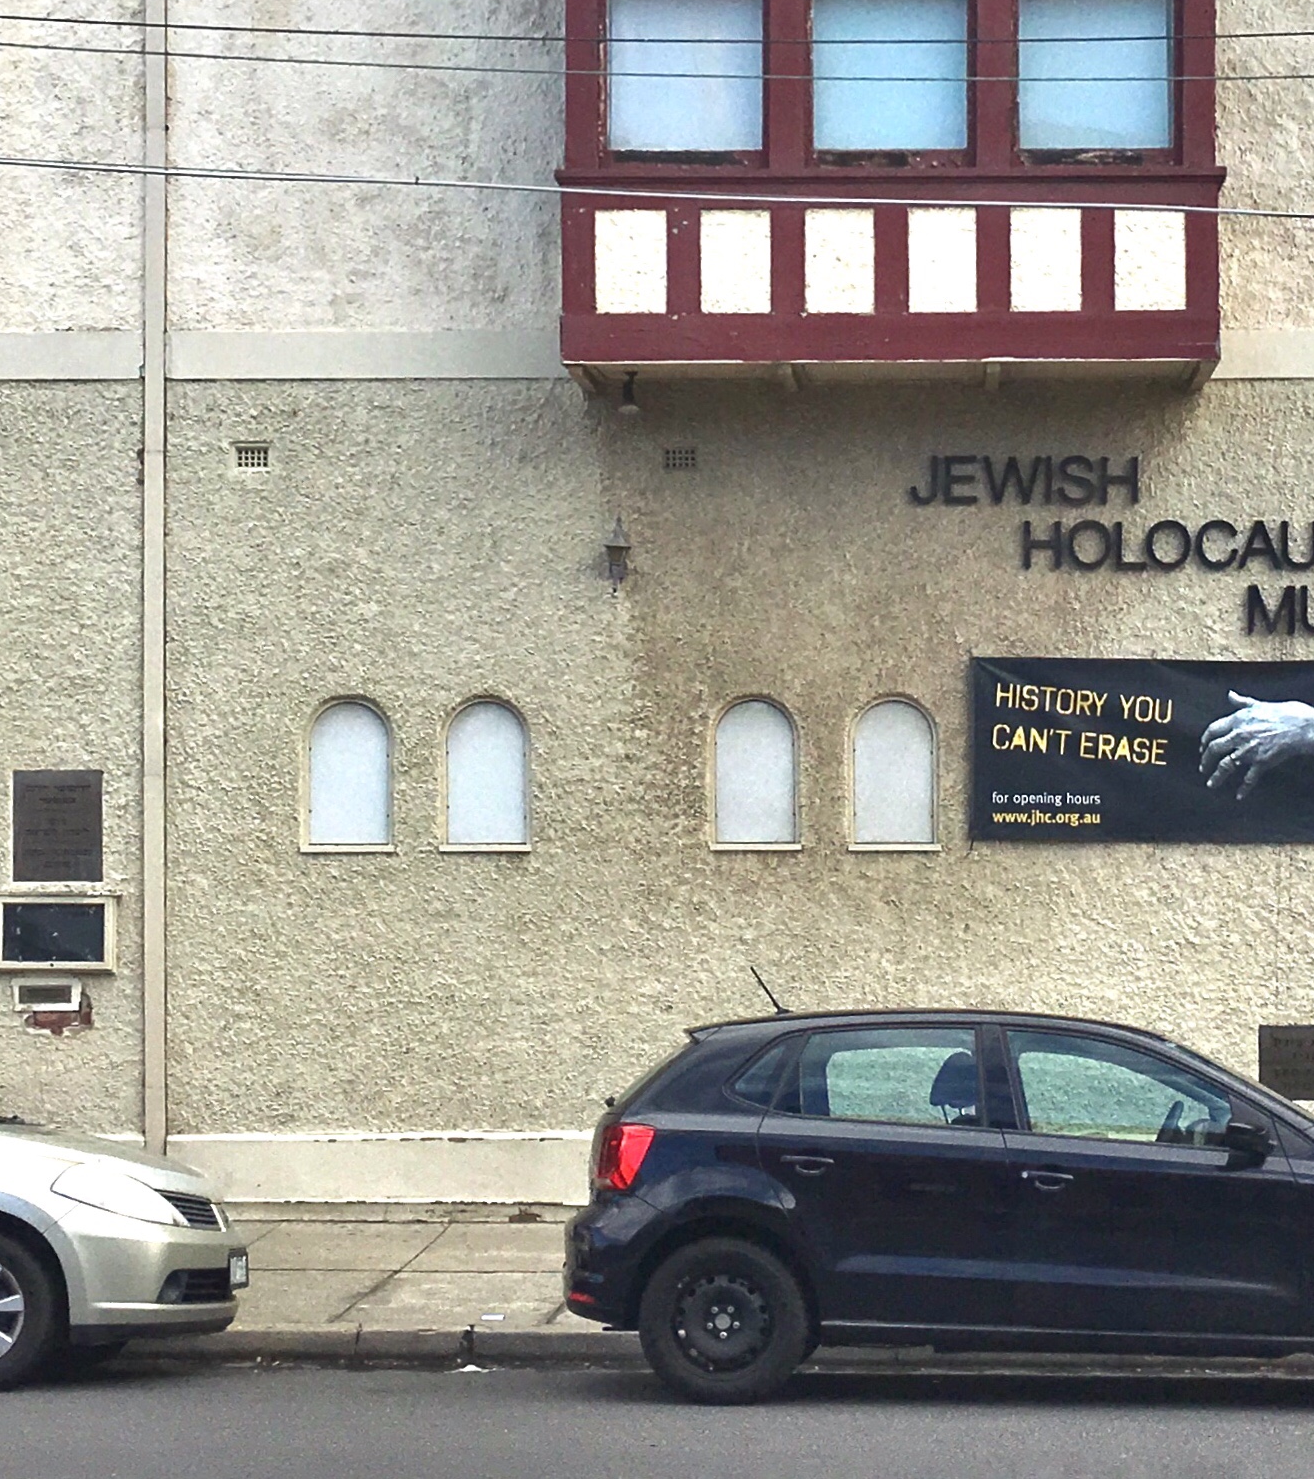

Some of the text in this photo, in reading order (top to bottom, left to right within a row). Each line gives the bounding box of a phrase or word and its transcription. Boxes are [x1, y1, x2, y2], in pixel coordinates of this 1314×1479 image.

[909, 454, 1140, 506] JEWISH
[995, 682, 1172, 723] HISTORY YOU
[992, 724, 1168, 765] CAN'T ERASE
[992, 791, 1101, 806] for opening hours
[992, 809, 1101, 827] www.jhc.org.au
